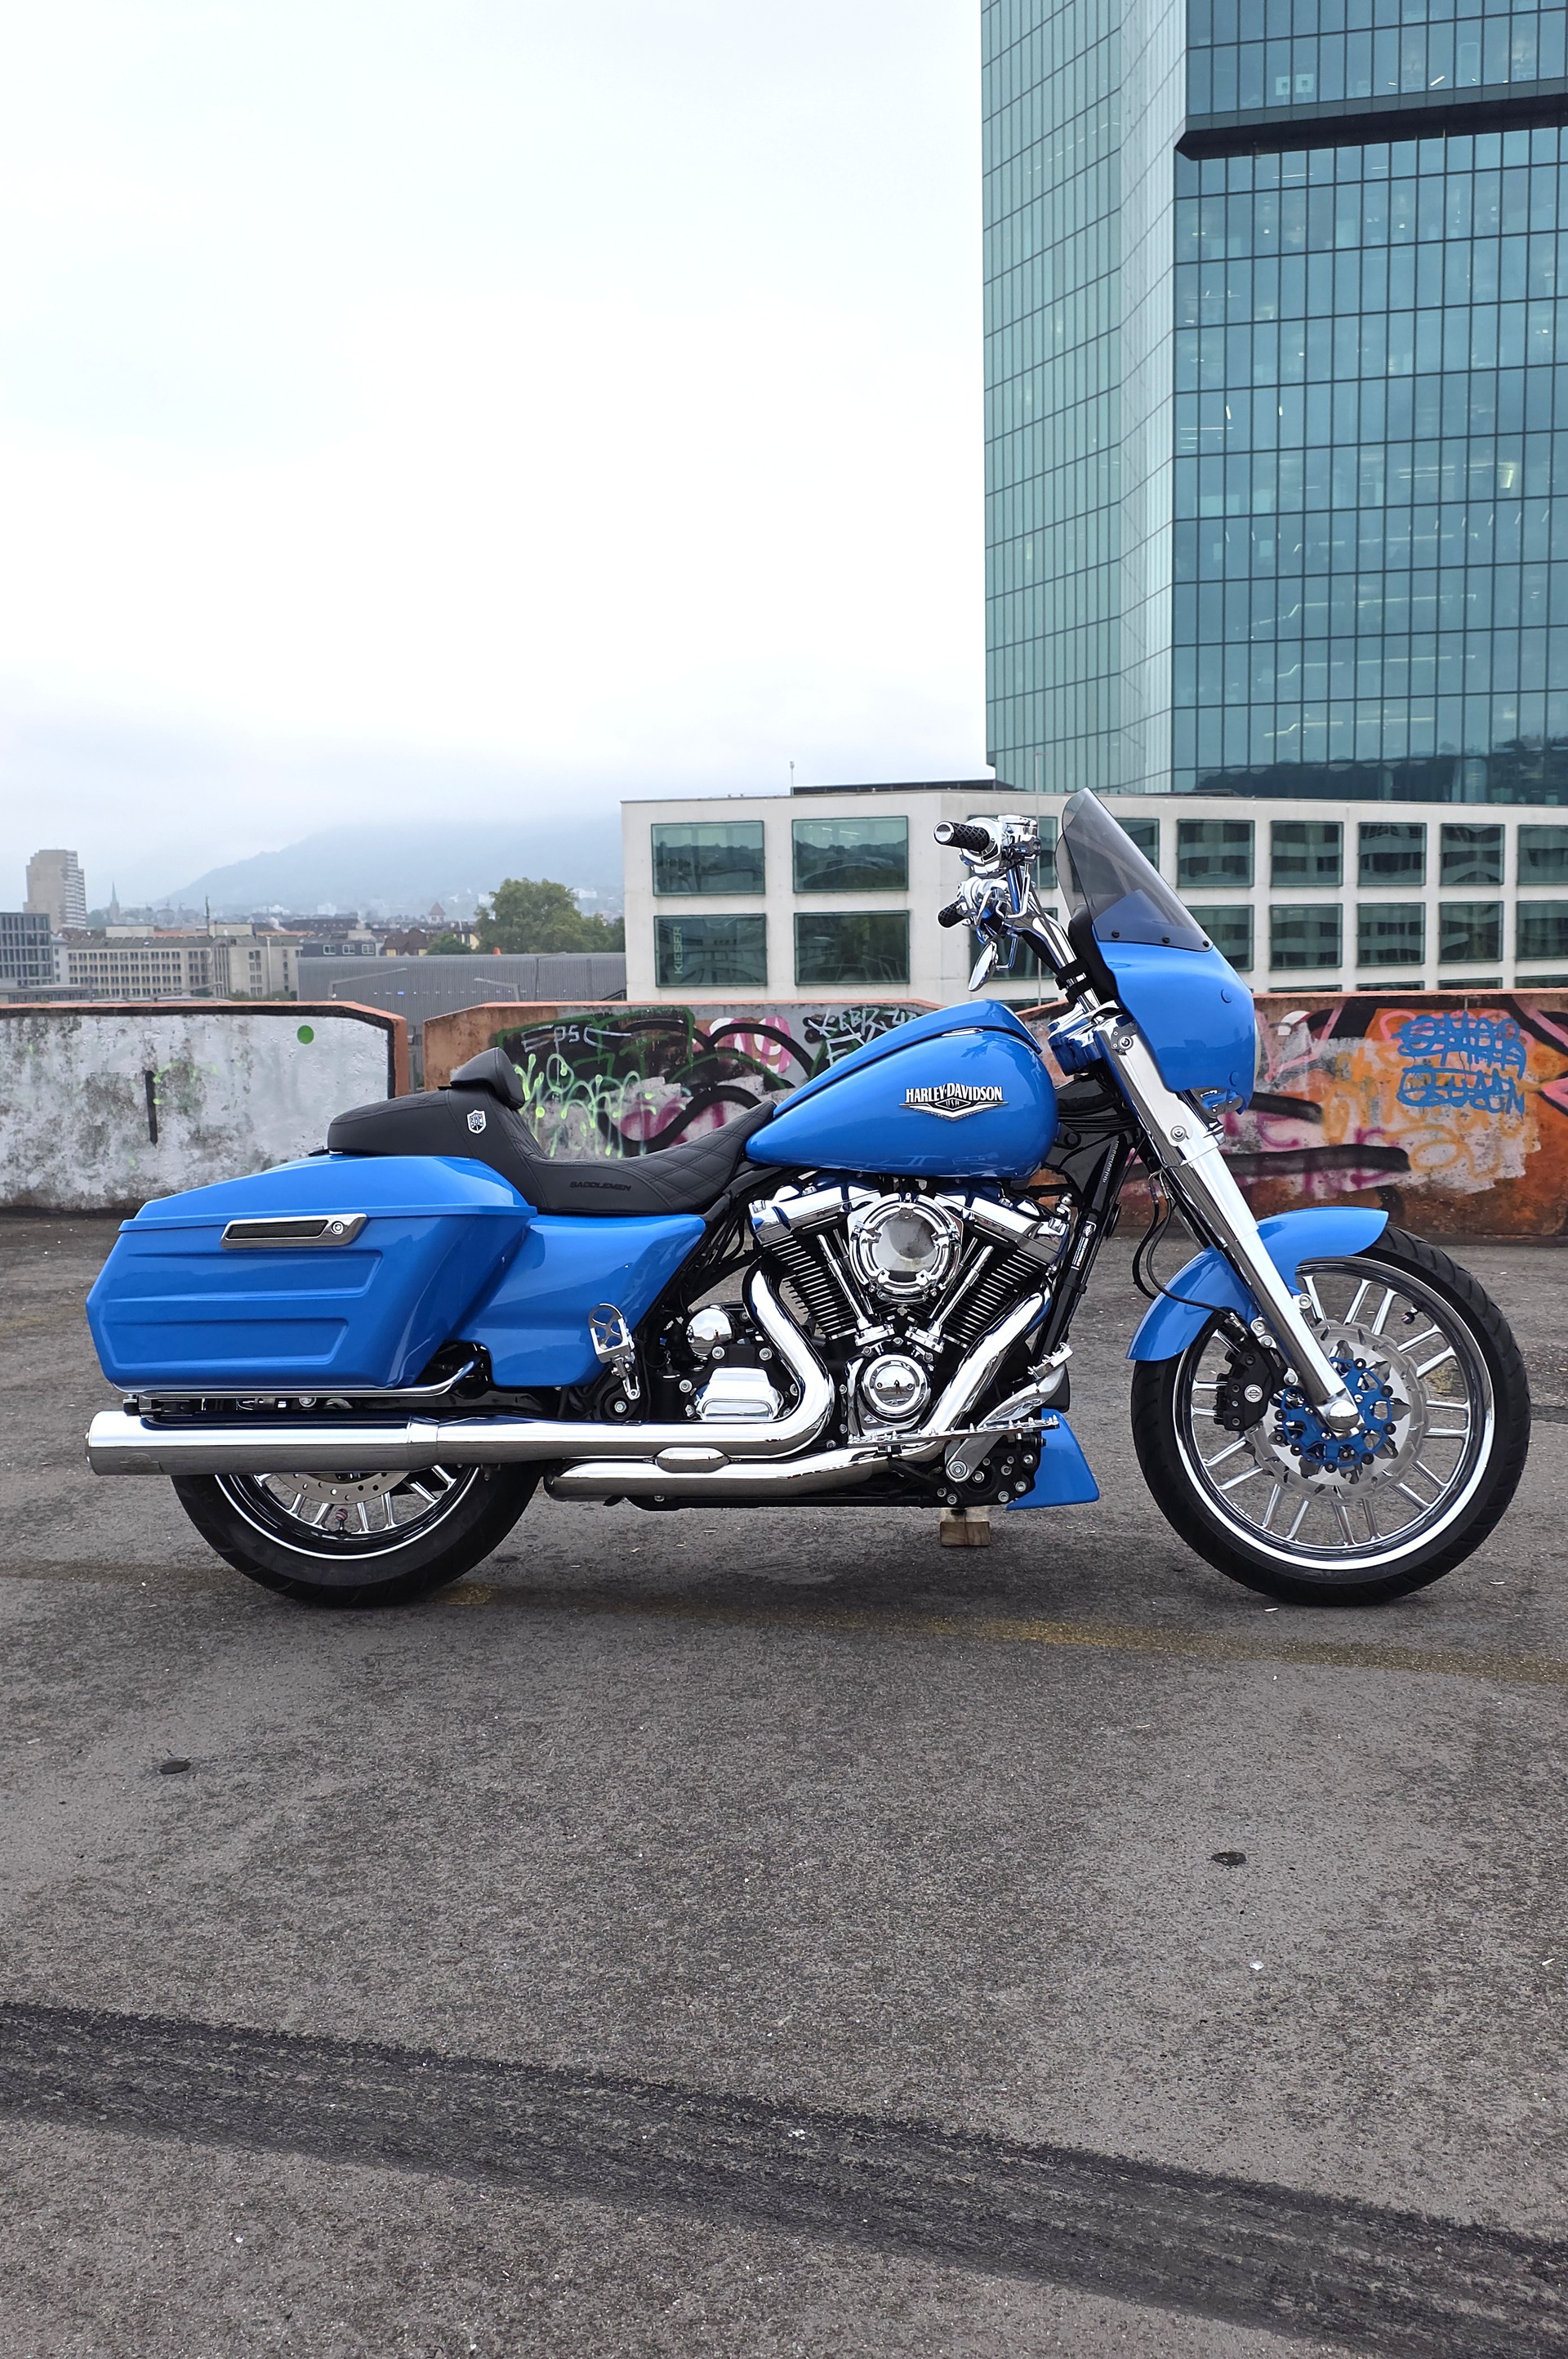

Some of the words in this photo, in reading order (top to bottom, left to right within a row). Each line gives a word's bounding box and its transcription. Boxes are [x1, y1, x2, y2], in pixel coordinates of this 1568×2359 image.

[673, 926, 684, 974] KIESER
[905, 1082, 1004, 1103] HARLEY-DAVIDSON
[945, 1099, 960, 1108] USA
[569, 1181, 632, 1192] SADDLEMEN
